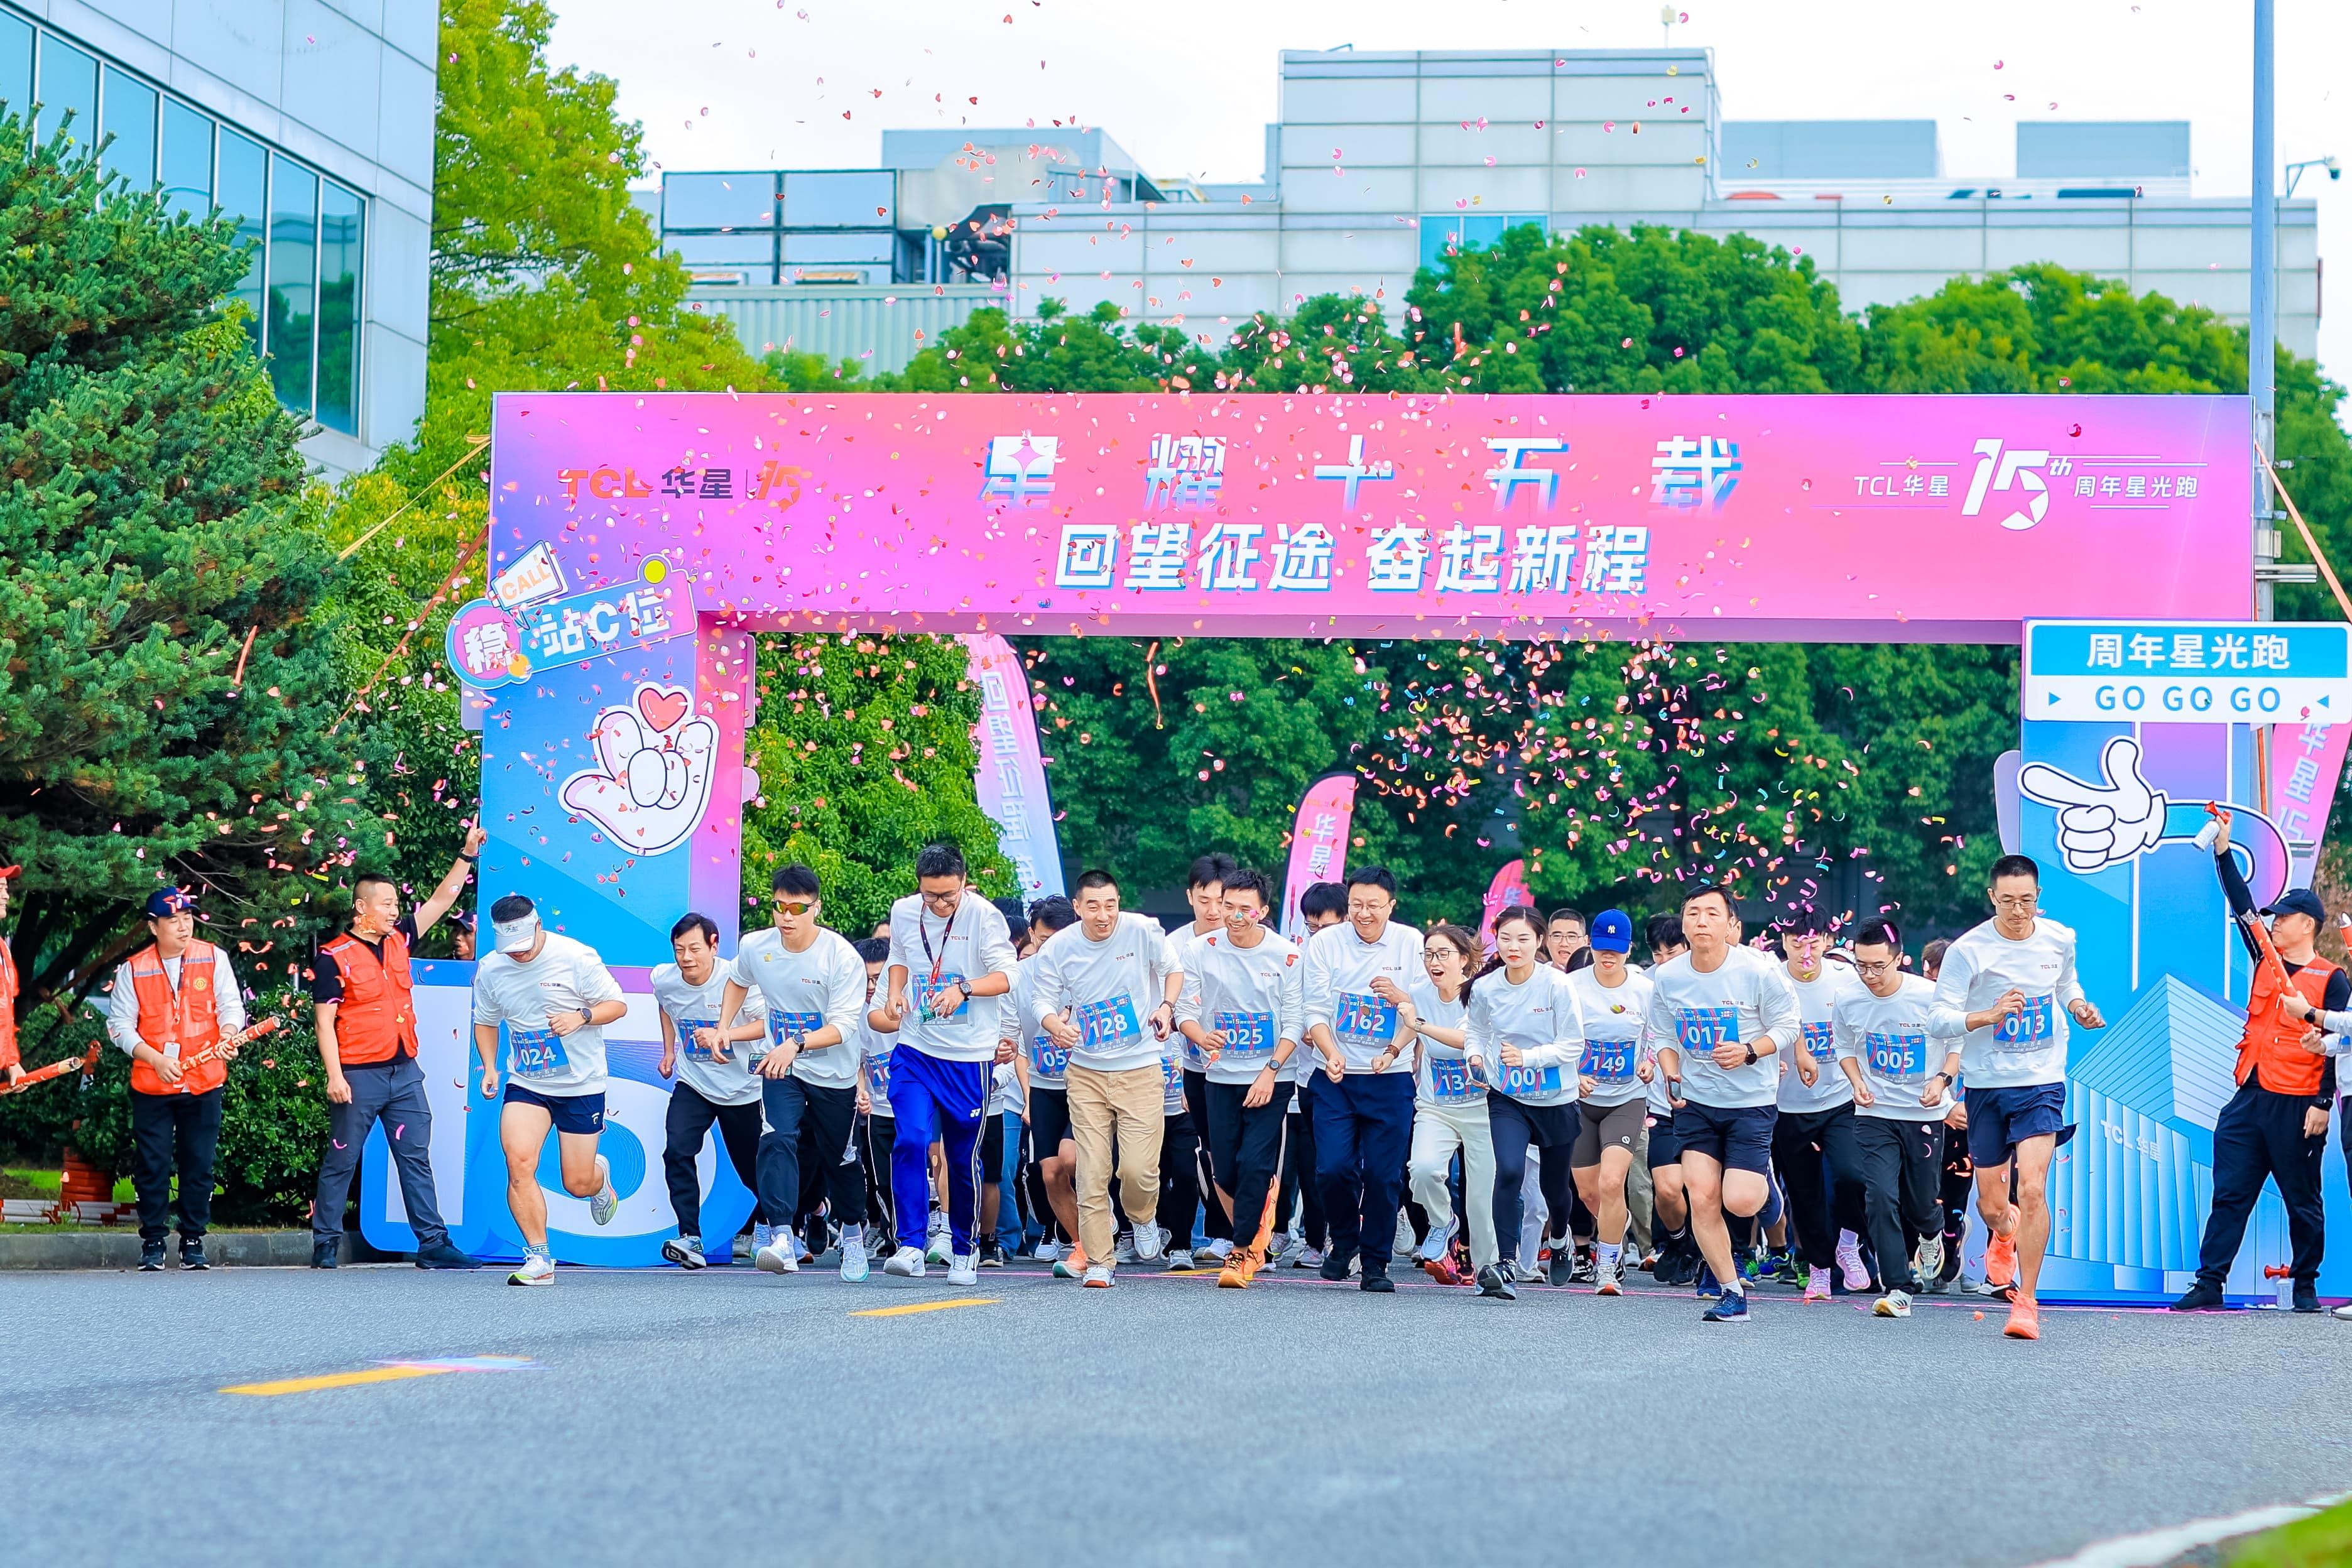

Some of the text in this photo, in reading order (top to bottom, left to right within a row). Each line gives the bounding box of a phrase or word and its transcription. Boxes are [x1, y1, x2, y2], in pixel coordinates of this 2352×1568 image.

[980, 433, 1743, 512] 星耀十五载
[557, 460, 802, 513] TCL 华星 15
[2074, 475, 2198, 498] 周年星光跑
[501, 562, 552, 601] CALL
[2086, 632, 2291, 671] 周年星光跑
[2095, 685, 2282, 713] GO GO GO
[1091, 1014, 1128, 1038] 128
[1349, 1010, 1385, 1032] 162
[2005, 1015, 2045, 1036] 013
[1227, 1028, 1263, 1045] 025
[1687, 1026, 1727, 1044] 017
[521, 1047, 557, 1066] 024
[1043, 1048, 1072, 1067] 05
[1591, 1056, 1626, 1072] 149
[1876, 1050, 1915, 1069] 005
[1510, 1068, 1547, 1087] 001
[2100, 1119, 2133, 1150] TCL
